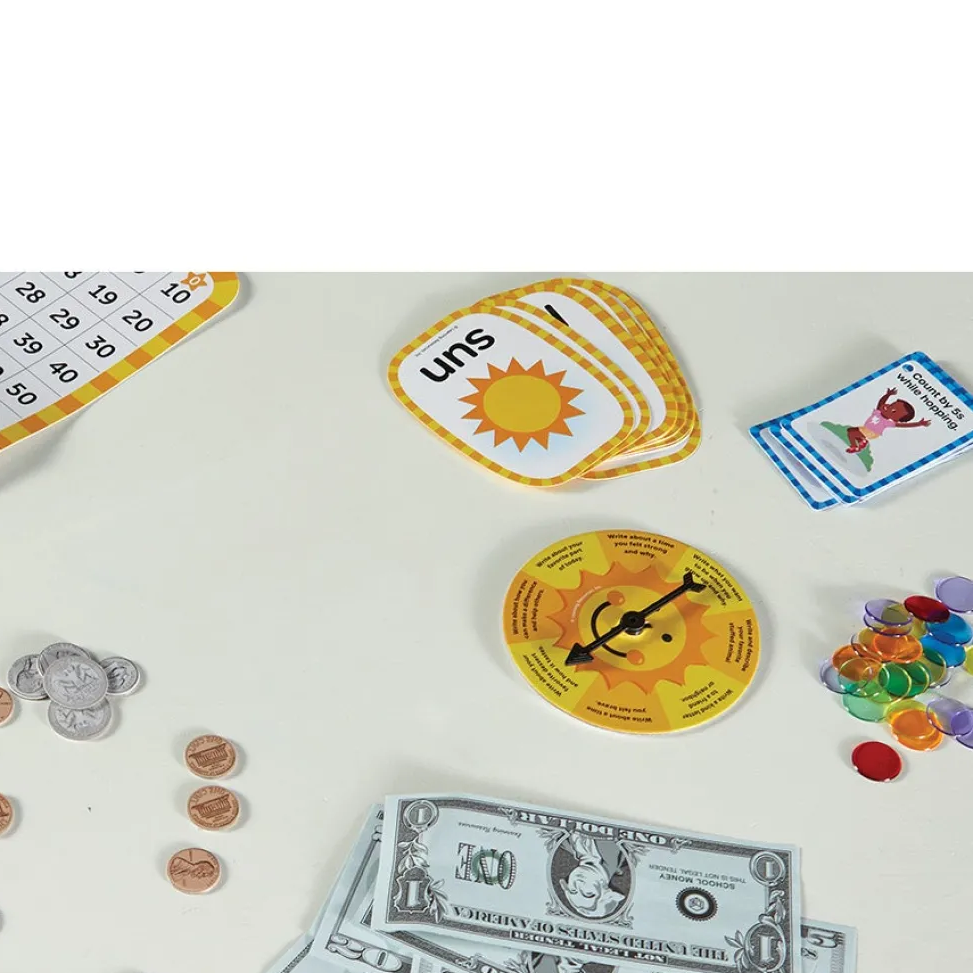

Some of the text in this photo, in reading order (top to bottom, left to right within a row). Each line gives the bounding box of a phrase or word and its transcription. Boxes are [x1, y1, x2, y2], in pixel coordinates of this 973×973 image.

[88, 285, 154, 332] 19 20
[160, 283, 191, 304] 10
[15, 281, 116, 358] 28 29 30
[13, 332, 43, 354] 39
[49, 362, 79, 383] 40
[419, 328, 495, 382] sun
[5, 382, 38, 405] 50
[897, 373, 958, 431] while hopping.
[913, 372, 965, 420] Count by 5s
[630, 534, 651, 542] about
[659, 540, 675, 549] time
[644, 543, 668, 554] strong
[587, 706, 603, 715] time
[610, 713, 631, 721] about
[518, 811, 667, 844] ONE DOLLAR
[453, 841, 518, 890] ONE
[659, 872, 735, 890] SCHOOL MONEY
[452, 906, 728, 961] THE UNITED STATES OF AMERICA
[513, 930, 664, 962] NOT LEGAL TENDER
[327, 934, 403, 972] 20
